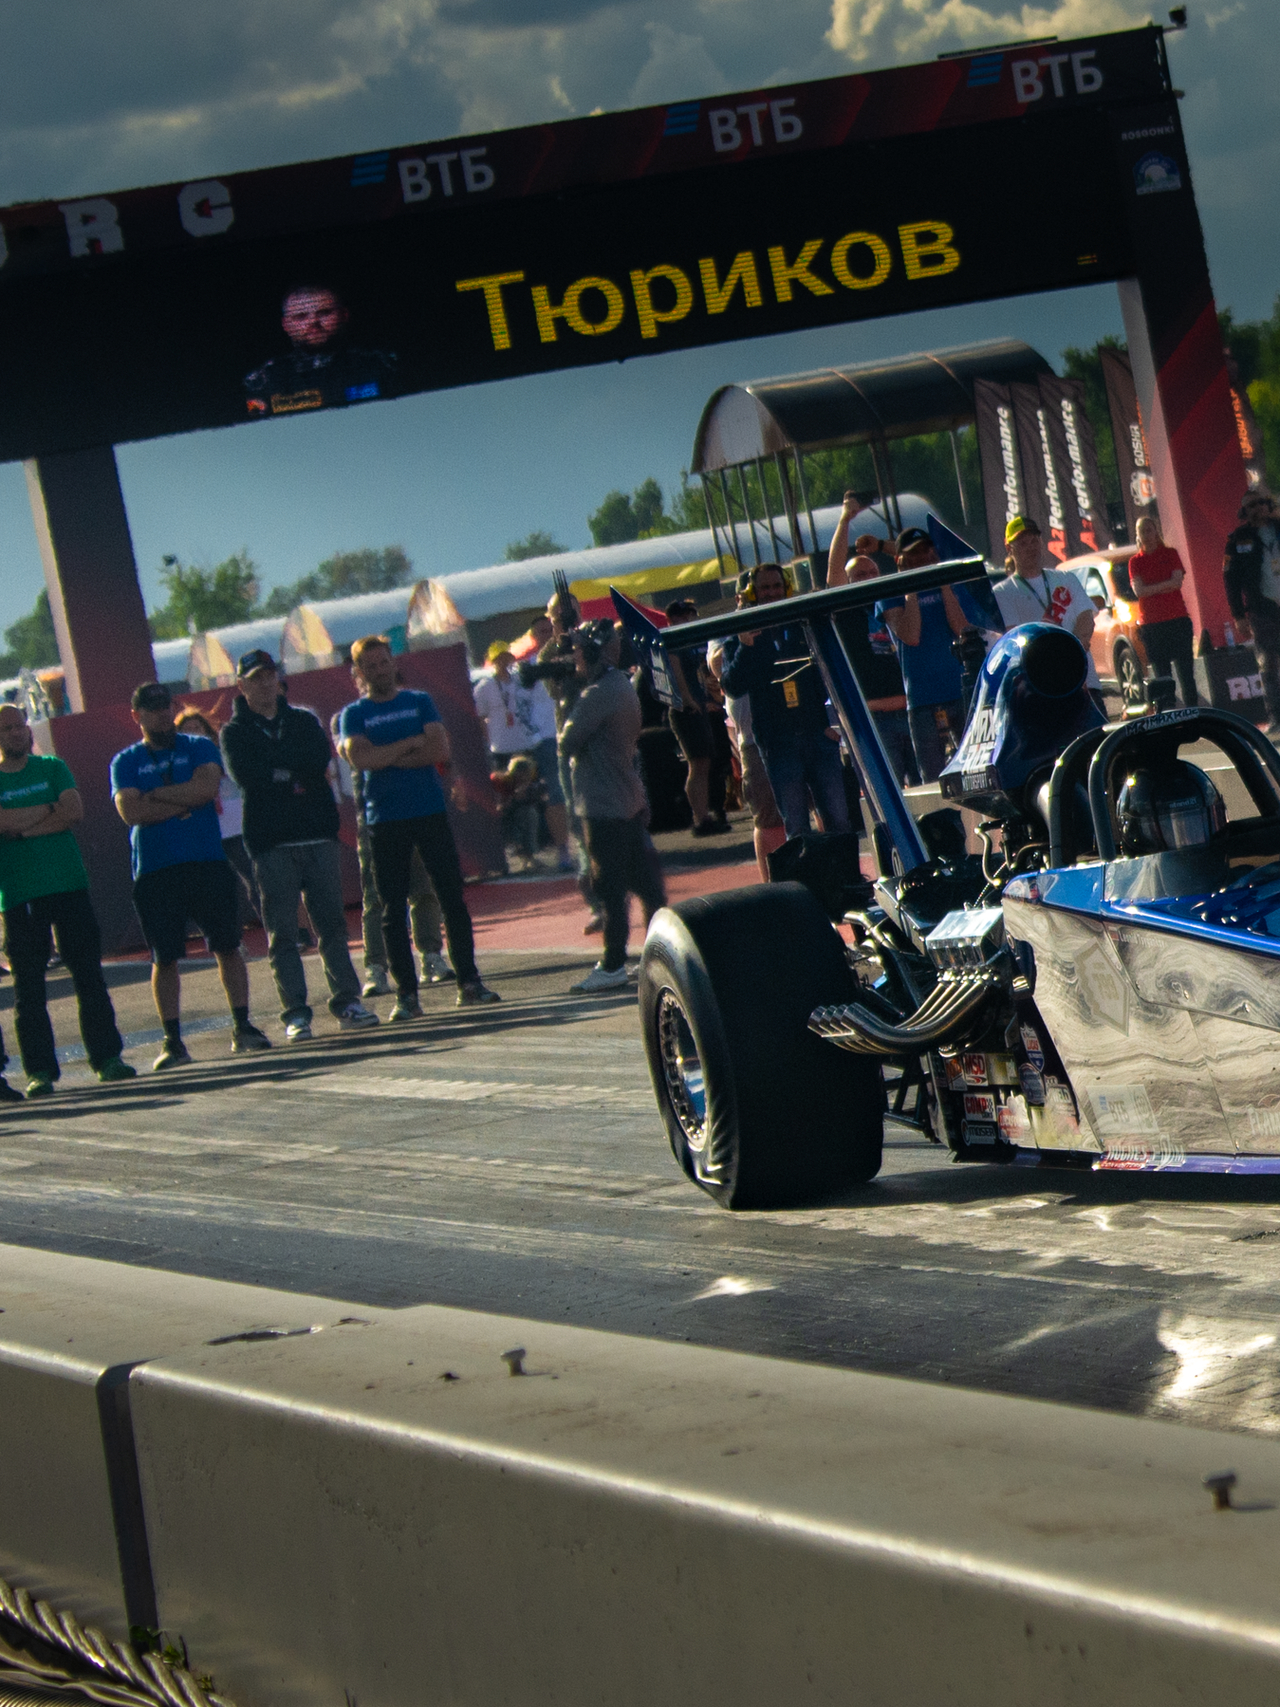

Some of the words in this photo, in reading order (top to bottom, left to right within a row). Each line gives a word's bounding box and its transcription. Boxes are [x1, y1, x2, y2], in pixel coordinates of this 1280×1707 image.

[1011, 50, 1102, 103] ВТБ
[708, 98, 803, 153] ВТБ
[398, 147, 496, 203] ВТБ
[456, 220, 961, 351] Тюриков
[964, 1053, 986, 1076] MSD
